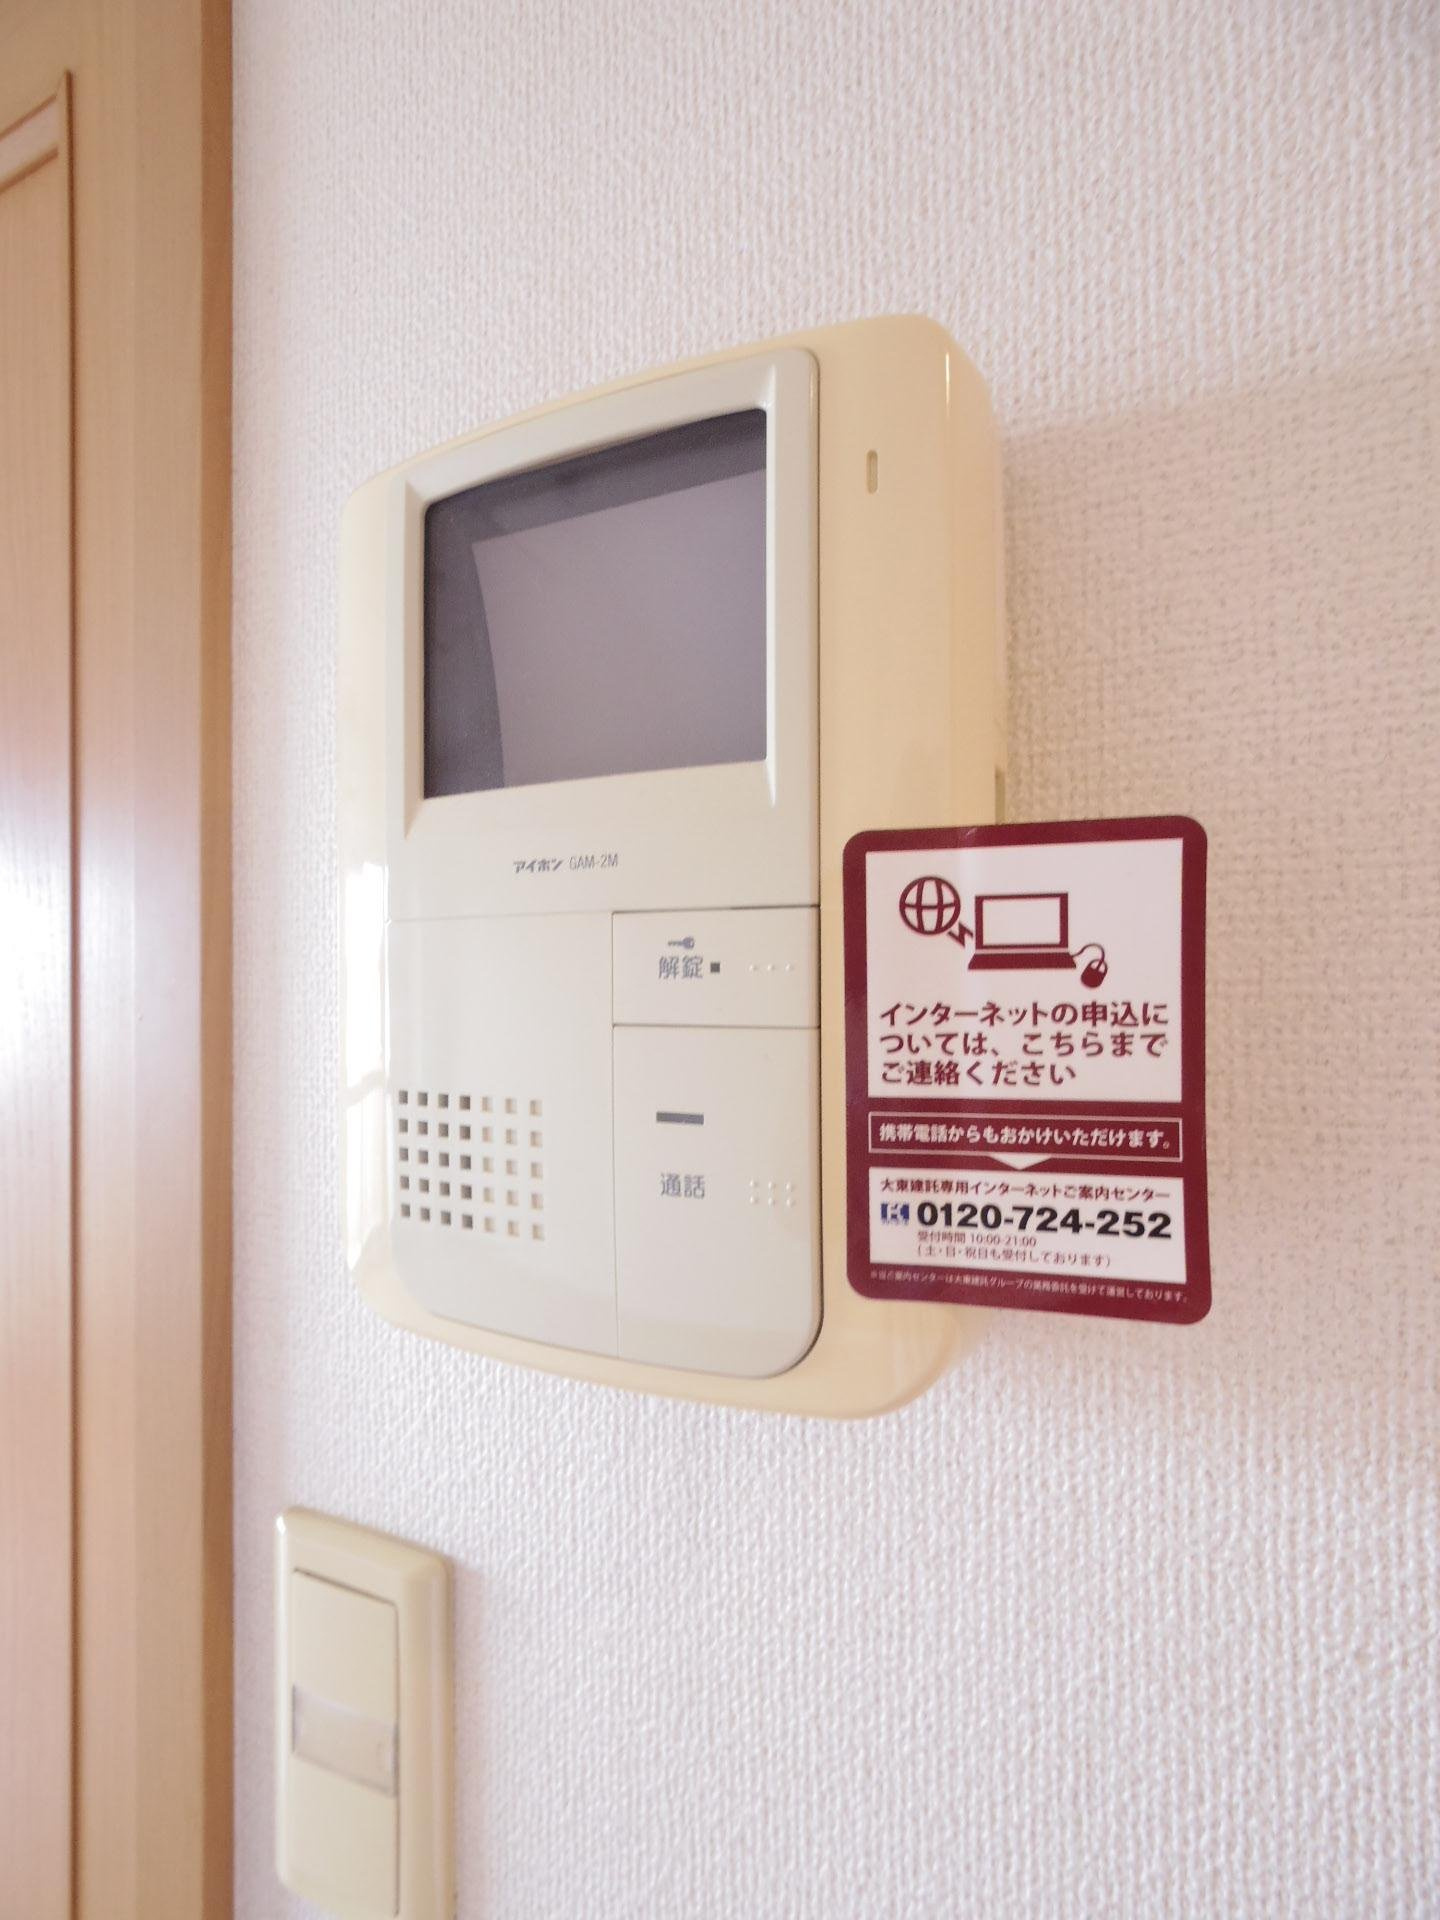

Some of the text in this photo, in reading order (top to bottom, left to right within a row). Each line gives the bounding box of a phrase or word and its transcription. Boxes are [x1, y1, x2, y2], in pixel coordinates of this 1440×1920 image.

[513, 858, 563, 874] アイホン
[658, 955, 704, 979] 解錠
[879, 1001, 1168, 1027] インターネットの申込に
[880, 1060, 1076, 1086] ご連絡ください
[879, 1122, 1170, 1150] 携帯電話からもおかけいただけます。
[660, 1173, 705, 1200] 通話
[917, 1202, 1172, 1239] 0120-724-252
